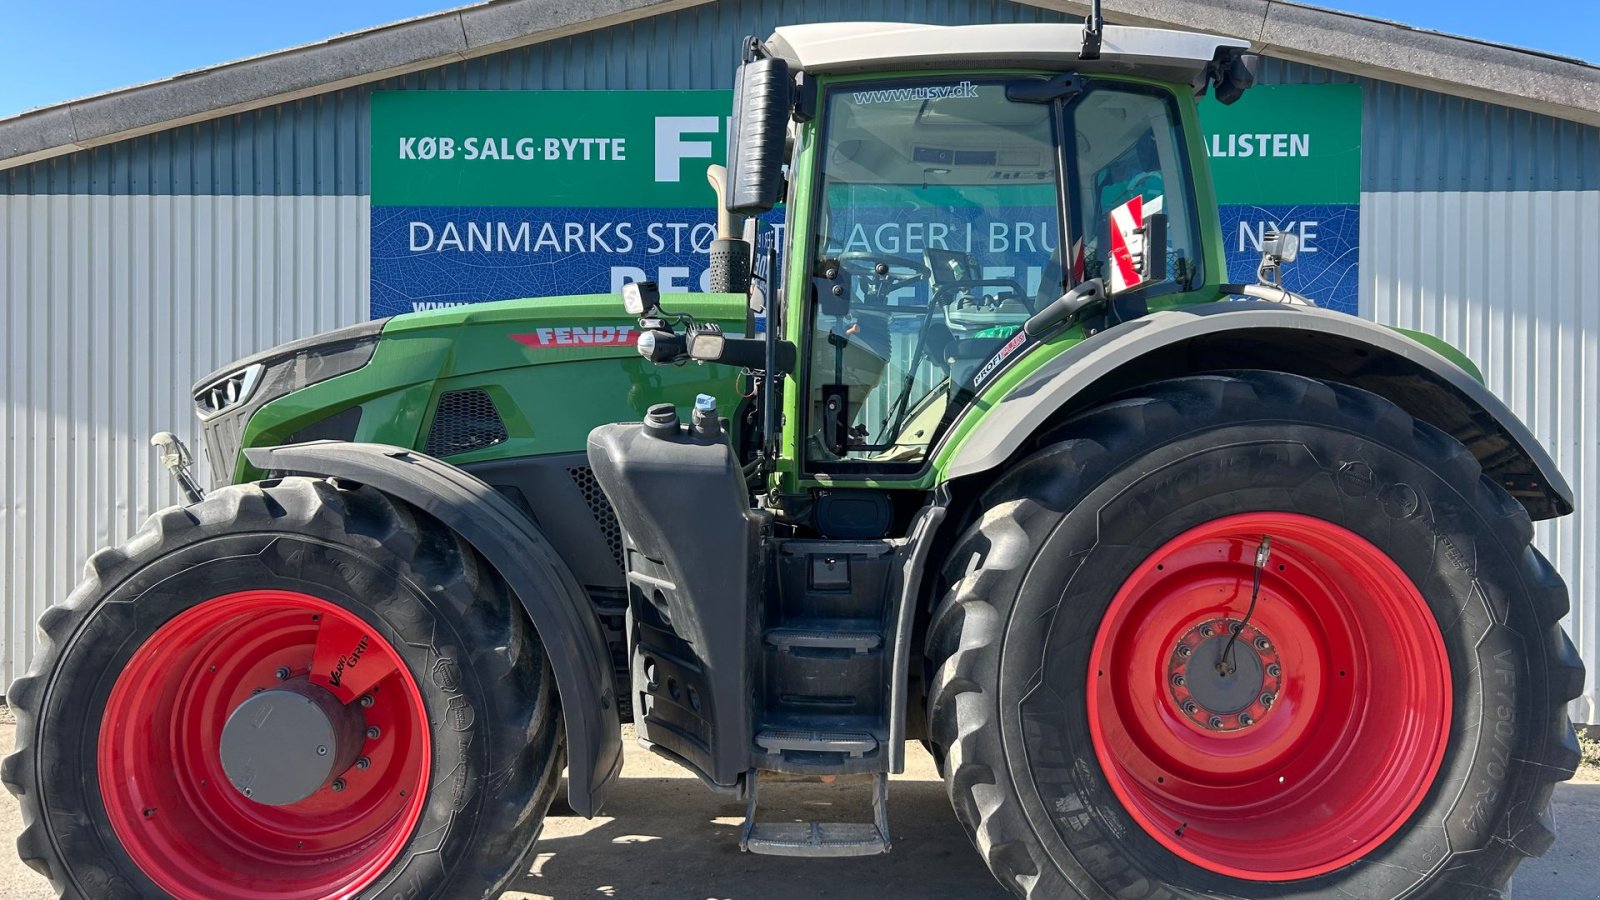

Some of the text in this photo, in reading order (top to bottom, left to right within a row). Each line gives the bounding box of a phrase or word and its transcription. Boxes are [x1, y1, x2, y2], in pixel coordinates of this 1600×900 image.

[853, 81, 979, 104] www.usv.dk
[654, 116, 732, 182] F
[1204, 134, 1310, 157] LISTEN
[409, 221, 633, 253] DANMARKS
[989, 222, 1058, 253] BRU
[536, 325, 635, 345] FENDT
[347, 635, 369, 668] GRIP
